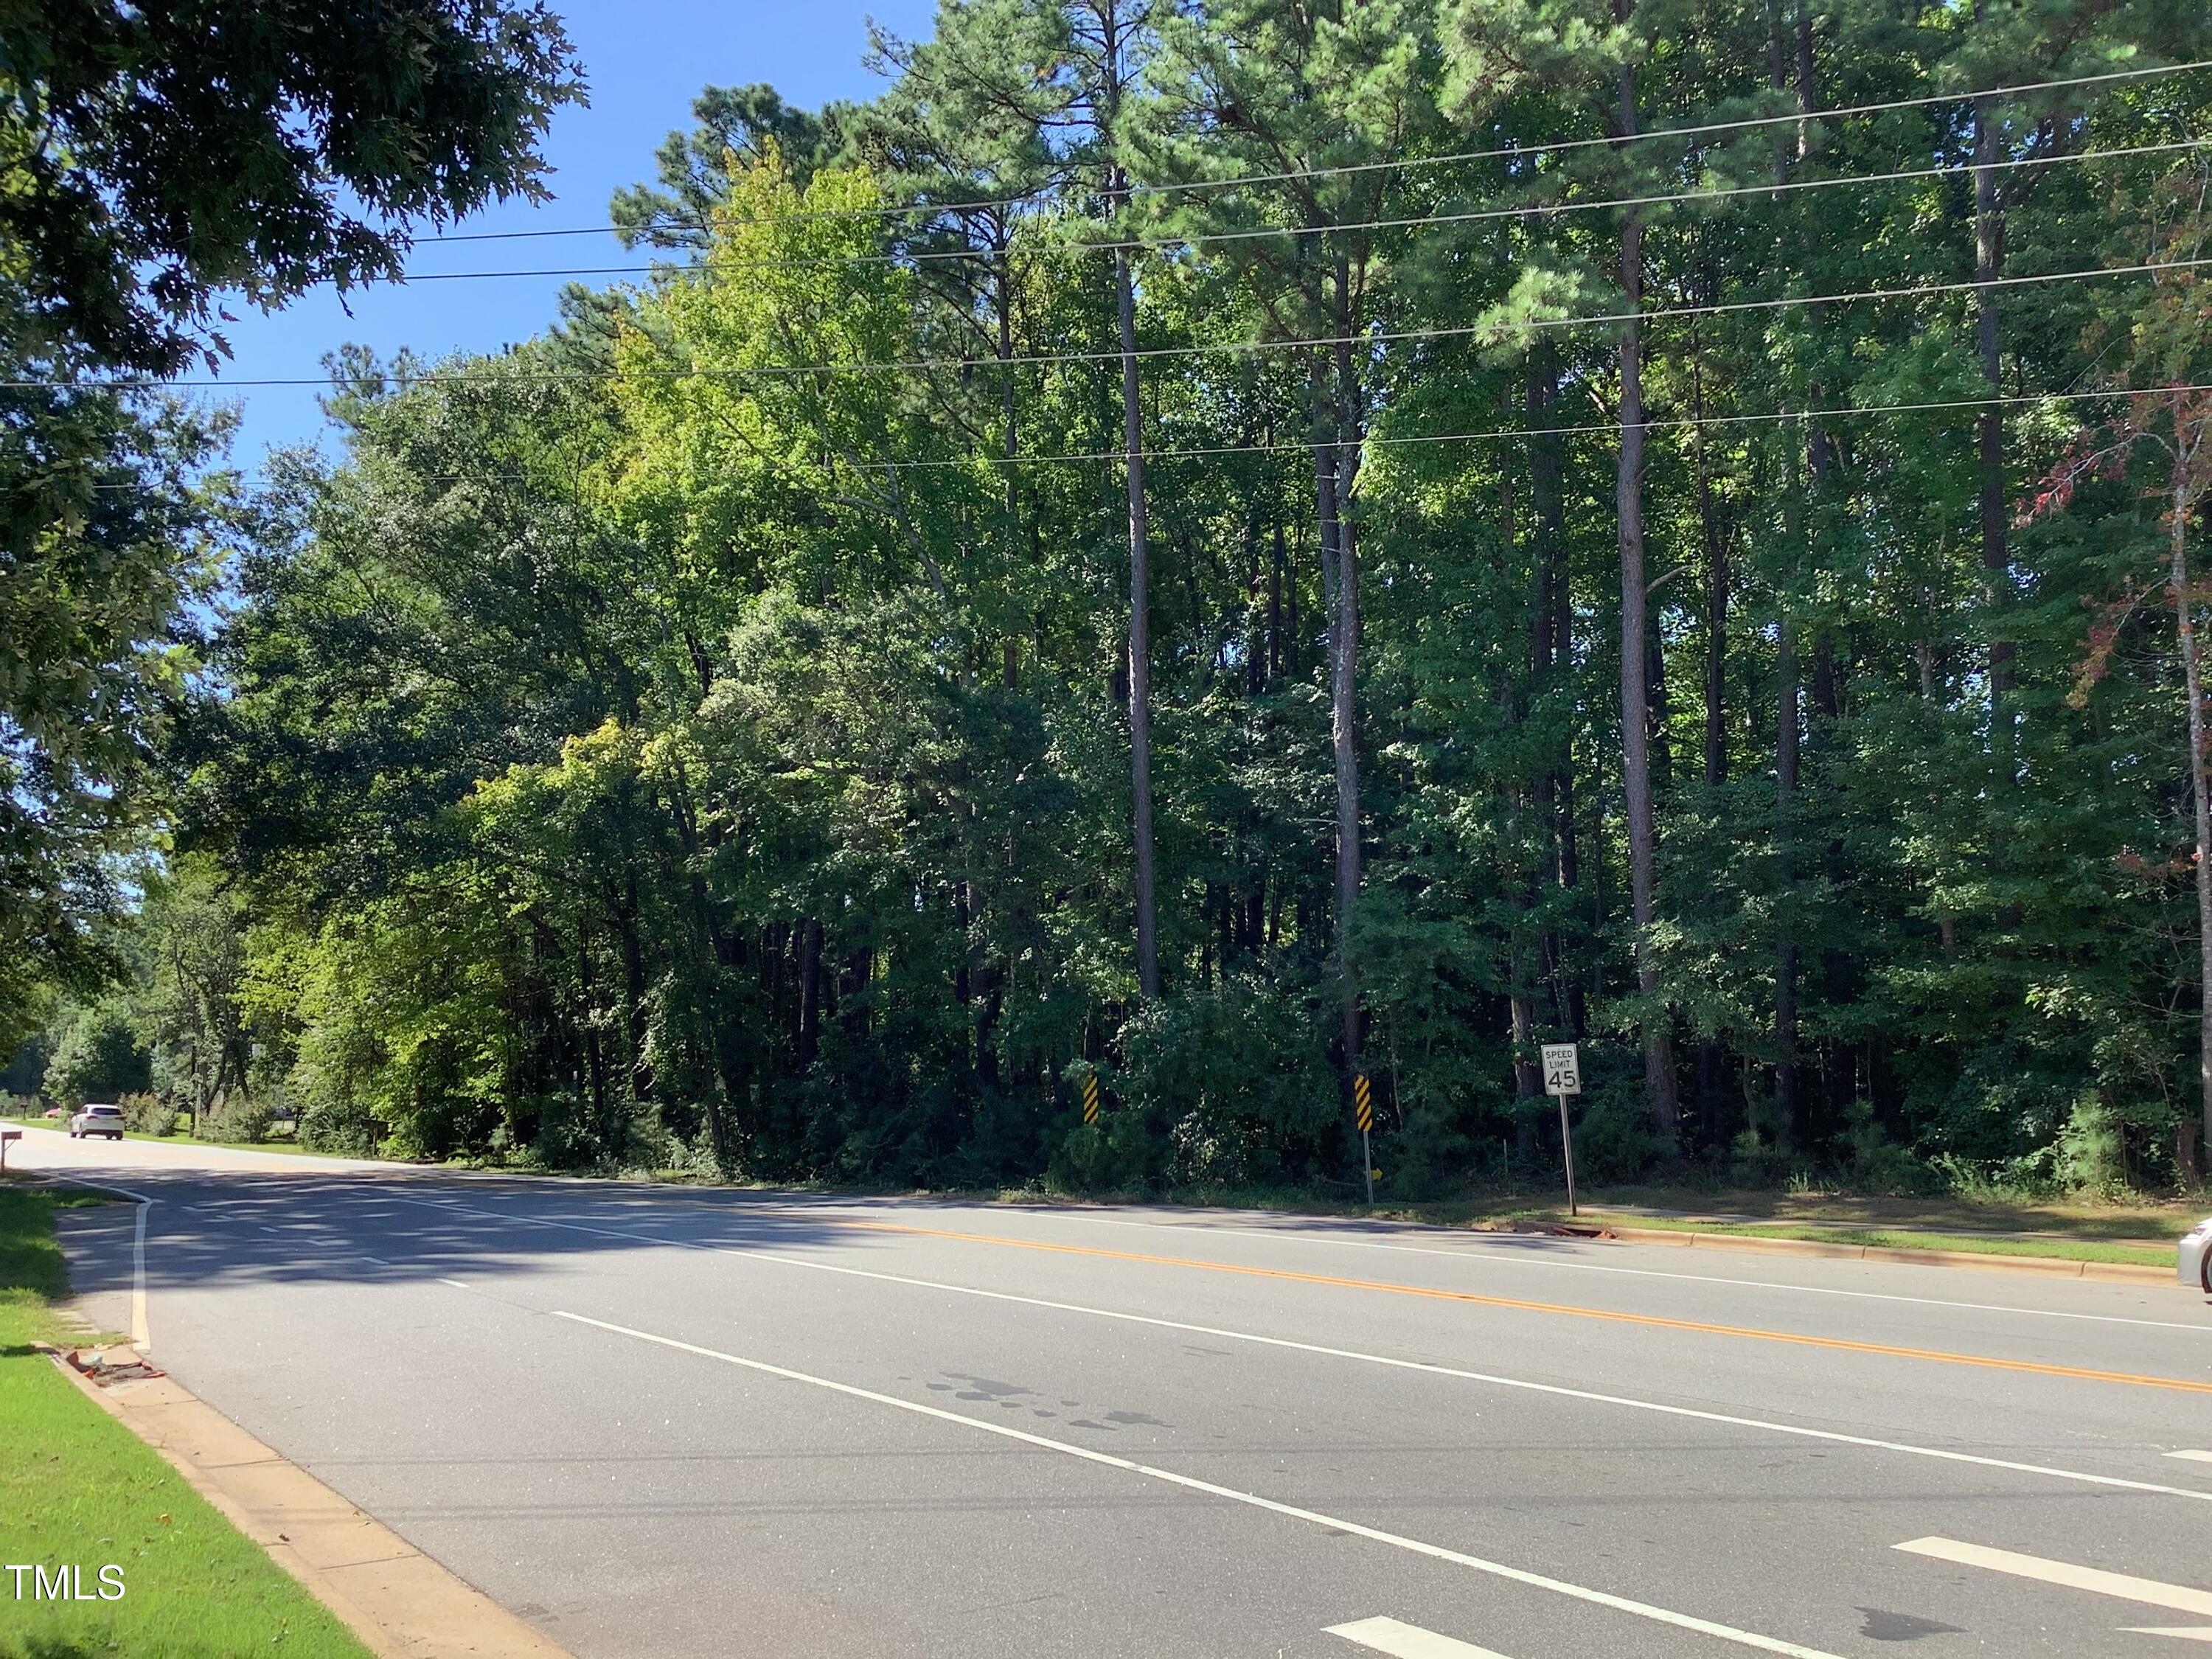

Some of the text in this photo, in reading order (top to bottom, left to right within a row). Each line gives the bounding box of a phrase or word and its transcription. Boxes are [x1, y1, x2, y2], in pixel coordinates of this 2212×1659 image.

[1545, 1050, 1573, 1059] SPEED
[1549, 1060, 1571, 1069] LIMIT
[1548, 1071, 1576, 1088] 45
